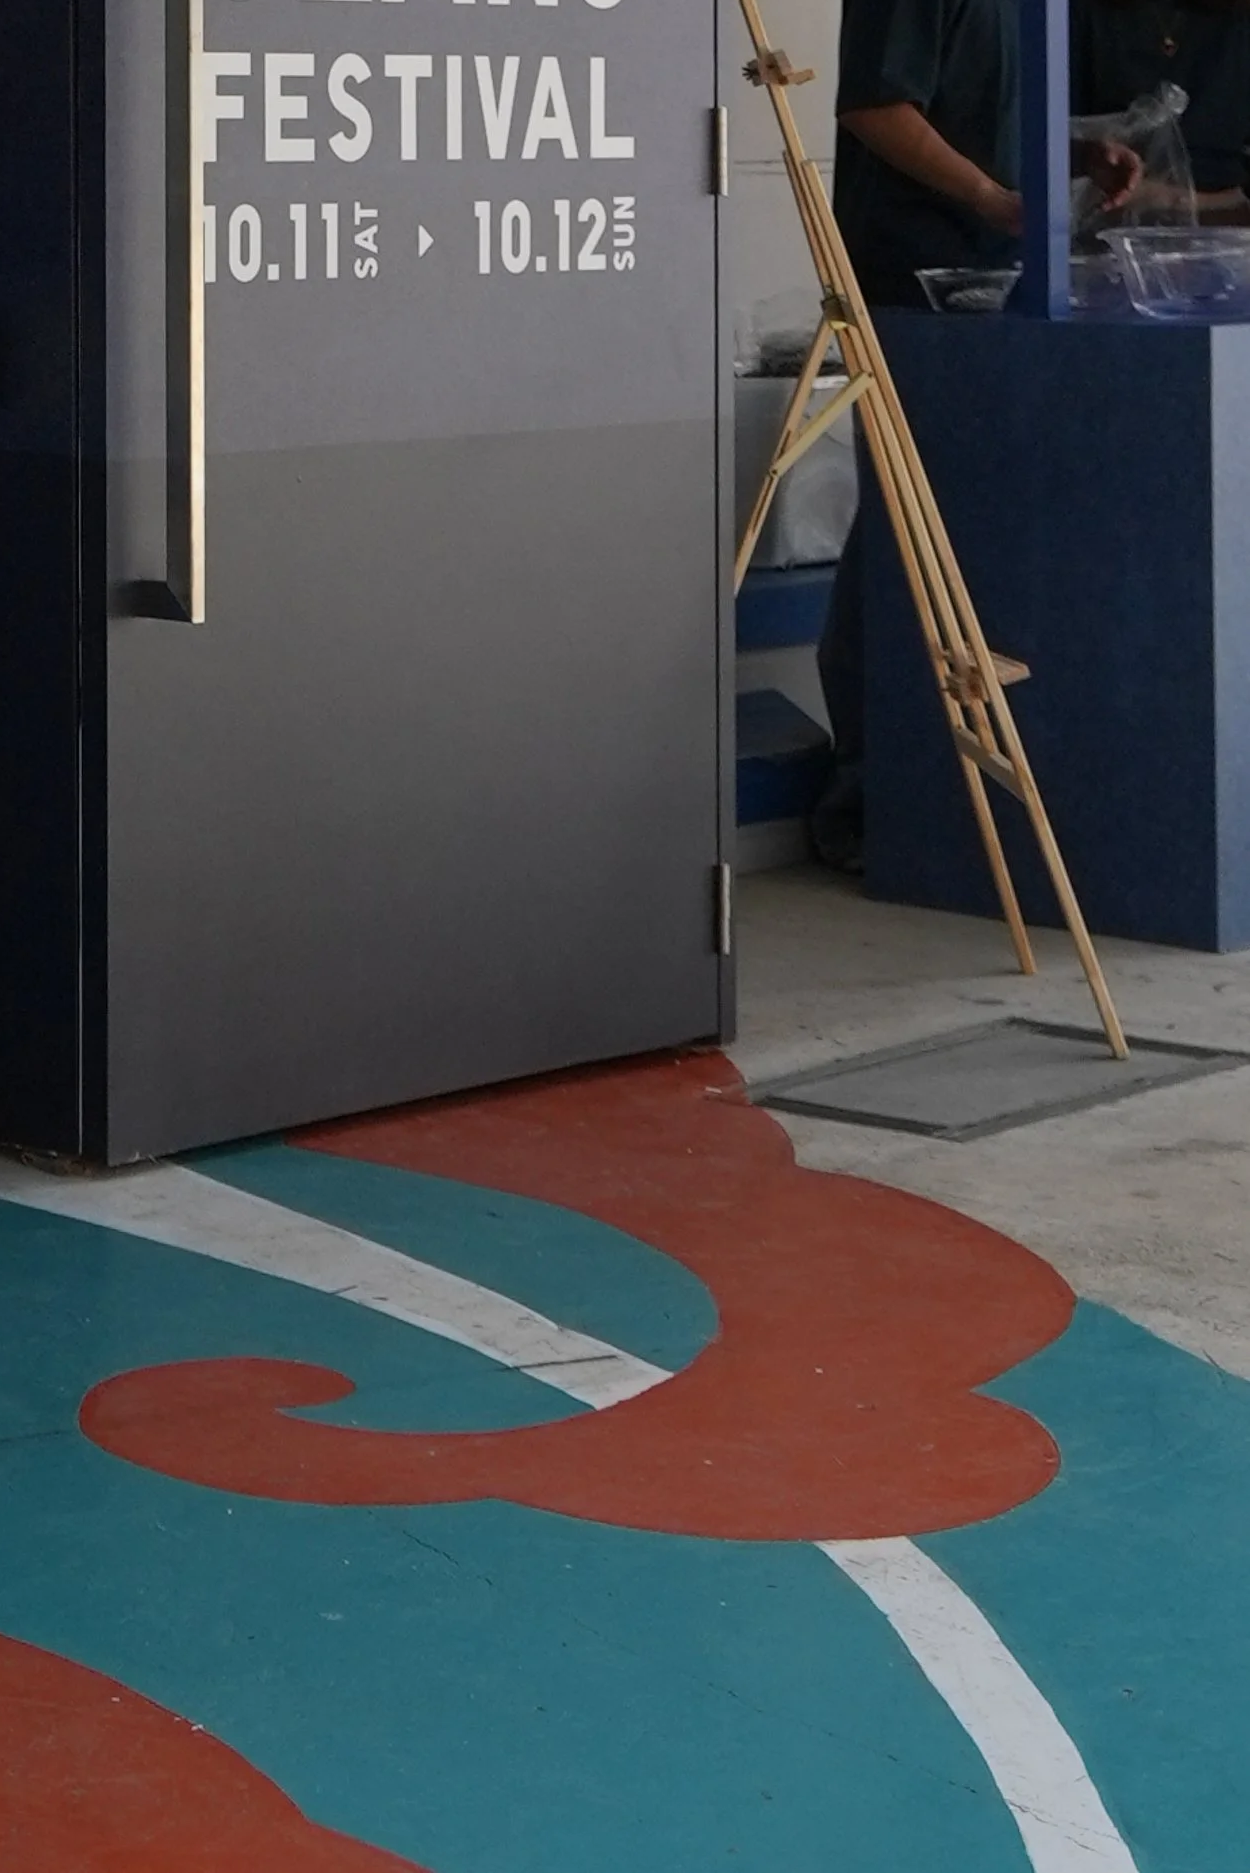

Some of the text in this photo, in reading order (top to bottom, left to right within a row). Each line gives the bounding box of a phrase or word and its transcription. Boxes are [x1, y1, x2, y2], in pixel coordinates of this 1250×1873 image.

[203, 51, 635, 163] FESTIVAL
[204, 196, 636, 283] 10.11 SAT 10.12 SUN
